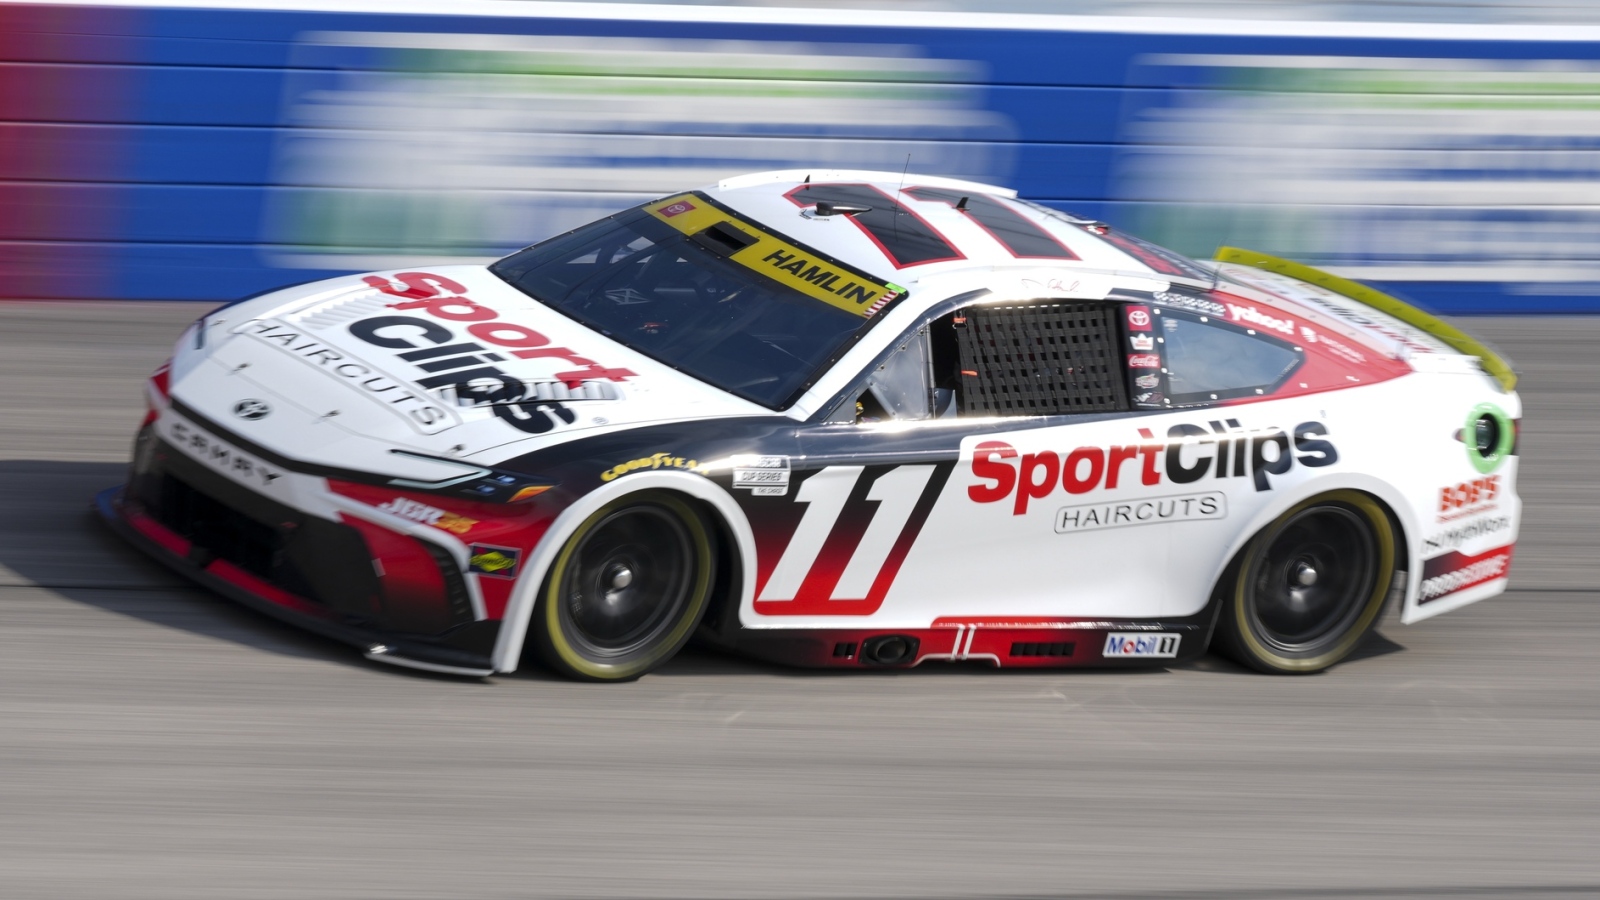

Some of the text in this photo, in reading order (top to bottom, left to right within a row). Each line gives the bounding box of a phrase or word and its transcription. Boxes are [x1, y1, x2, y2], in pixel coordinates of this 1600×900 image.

[782, 183, 1083, 270] 11
[762, 250, 877, 305] HAMLIN
[362, 271, 638, 390] Sport
[253, 317, 447, 429] HAIRCUTS
[349, 315, 576, 434] Clips
[171, 422, 282, 485] CAMRY
[600, 452, 709, 481] GOODYEAR
[756, 465, 937, 601] 11
[1061, 496, 1218, 528] HAIRCUTS
[1107, 635, 1157, 654] Mobil
